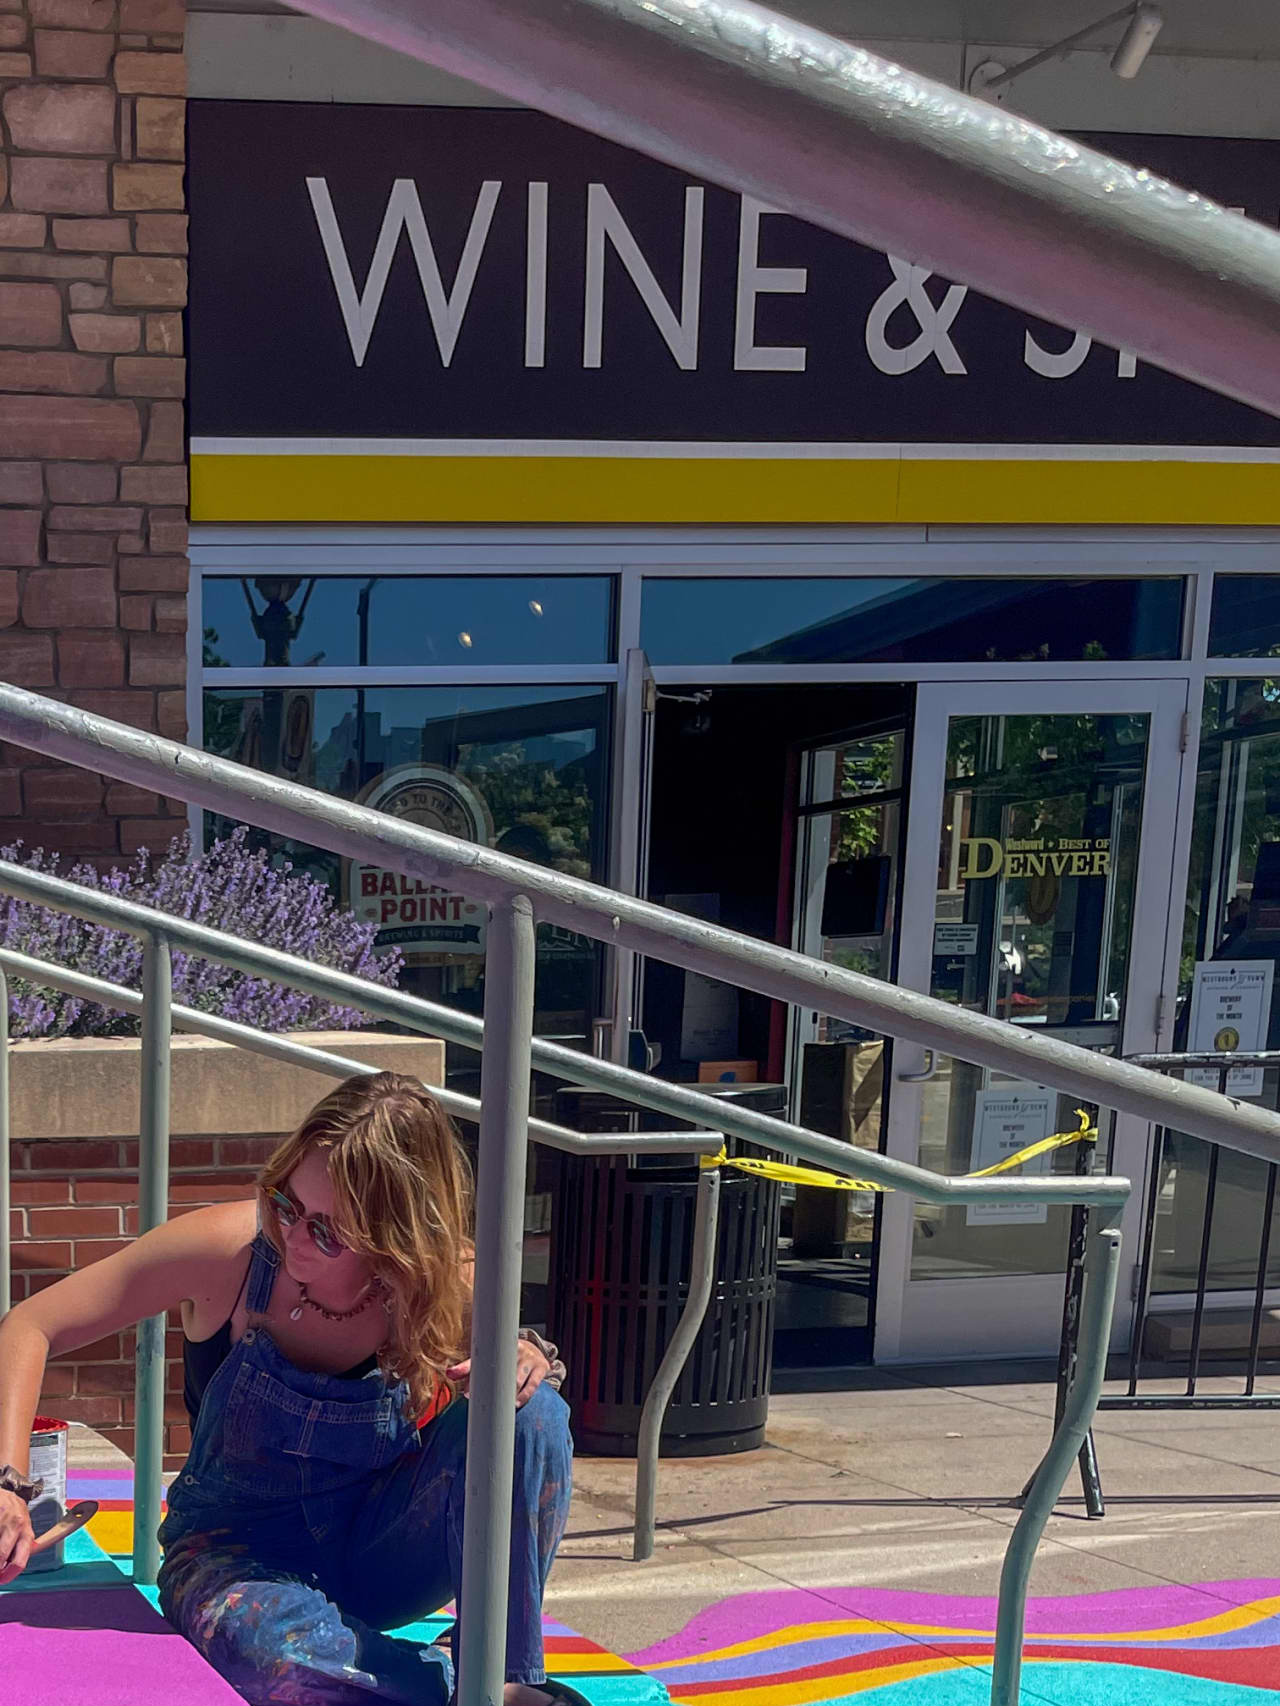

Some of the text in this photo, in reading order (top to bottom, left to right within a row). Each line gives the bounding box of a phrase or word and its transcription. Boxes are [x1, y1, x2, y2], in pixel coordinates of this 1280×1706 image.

[306, 176, 968, 375] WINE &
[960, 837, 1112, 879] DENVER
[1058, 838, 1091, 850] BEST
[1095, 838, 1111, 849] OF
[380, 895, 465, 923] POINT
